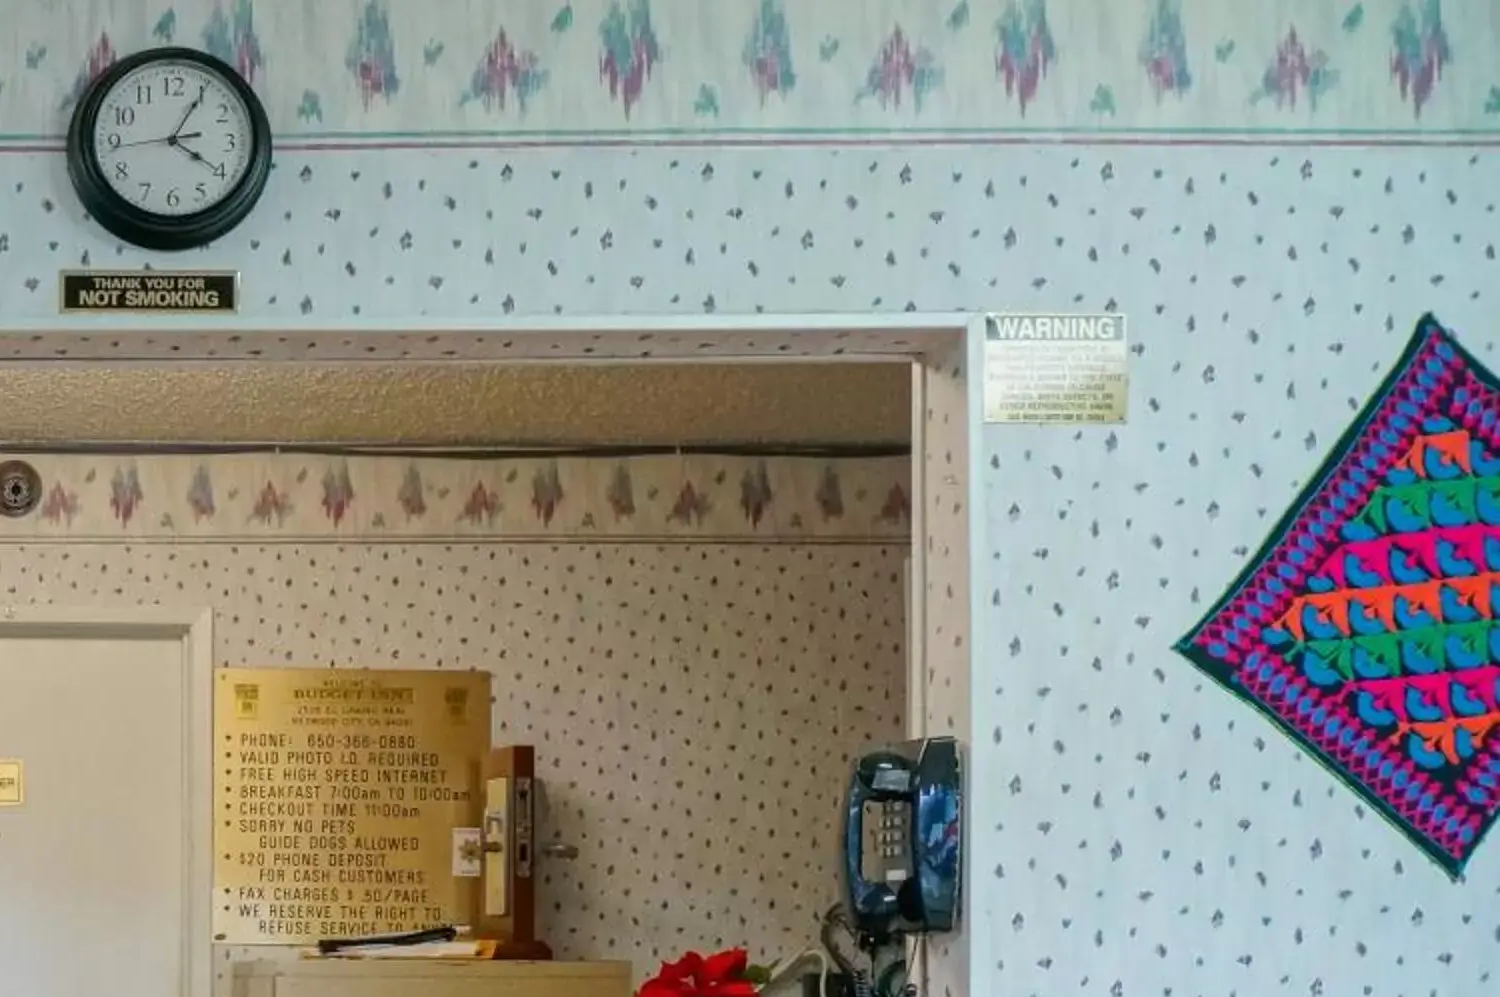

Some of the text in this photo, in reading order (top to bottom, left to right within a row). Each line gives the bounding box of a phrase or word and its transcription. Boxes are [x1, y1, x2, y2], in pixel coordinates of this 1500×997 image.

[136, 85, 151, 104] 11
[163, 77, 185, 96] 12
[114, 107, 135, 126] 10
[216, 104, 229, 123] 2
[107, 133, 121, 149] 9
[224, 134, 236, 151] 3
[115, 162, 129, 180] 8
[213, 163, 227, 180] 4
[138, 183, 151, 201] 7
[166, 189, 180, 208] 6
[195, 183, 207, 201] 5
[94, 277, 205, 289] THANK YOU FOR
[79, 290, 220, 307] NOT SMOKING
[995, 316, 1116, 339] WARNING
[241, 733, 293, 748] PHONE:
[240, 751, 279, 765] VALID
[286, 751, 333, 765] PHOTO
[367, 752, 440, 766] REQUIRED
[240, 768, 448, 783] FREE HIGH SPEED INTERNET
[240, 785, 322, 799] BREAKFAST
[330, 786, 381, 800] 7:00am
[388, 787, 405, 800] TO
[239, 802, 313, 816] CHECKOUT
[322, 803, 357, 816] TIME
[239, 819, 356, 834] SORRY NO PETS
[259, 836, 420, 851] GUIDE DOGS ALLOWED
[239, 853, 387, 868] $20 PHONE DEPOSIT
[259, 869, 425, 884] FOR CASH CUSTOMERS
[239, 887, 265, 899] FAX
[275, 888, 340, 900] CHARGES
[239, 905, 442, 921] WE RESERVE THE RIGHT TO
[259, 921, 312, 935] REFUSE
[320, 921, 377, 936] SERVICE
